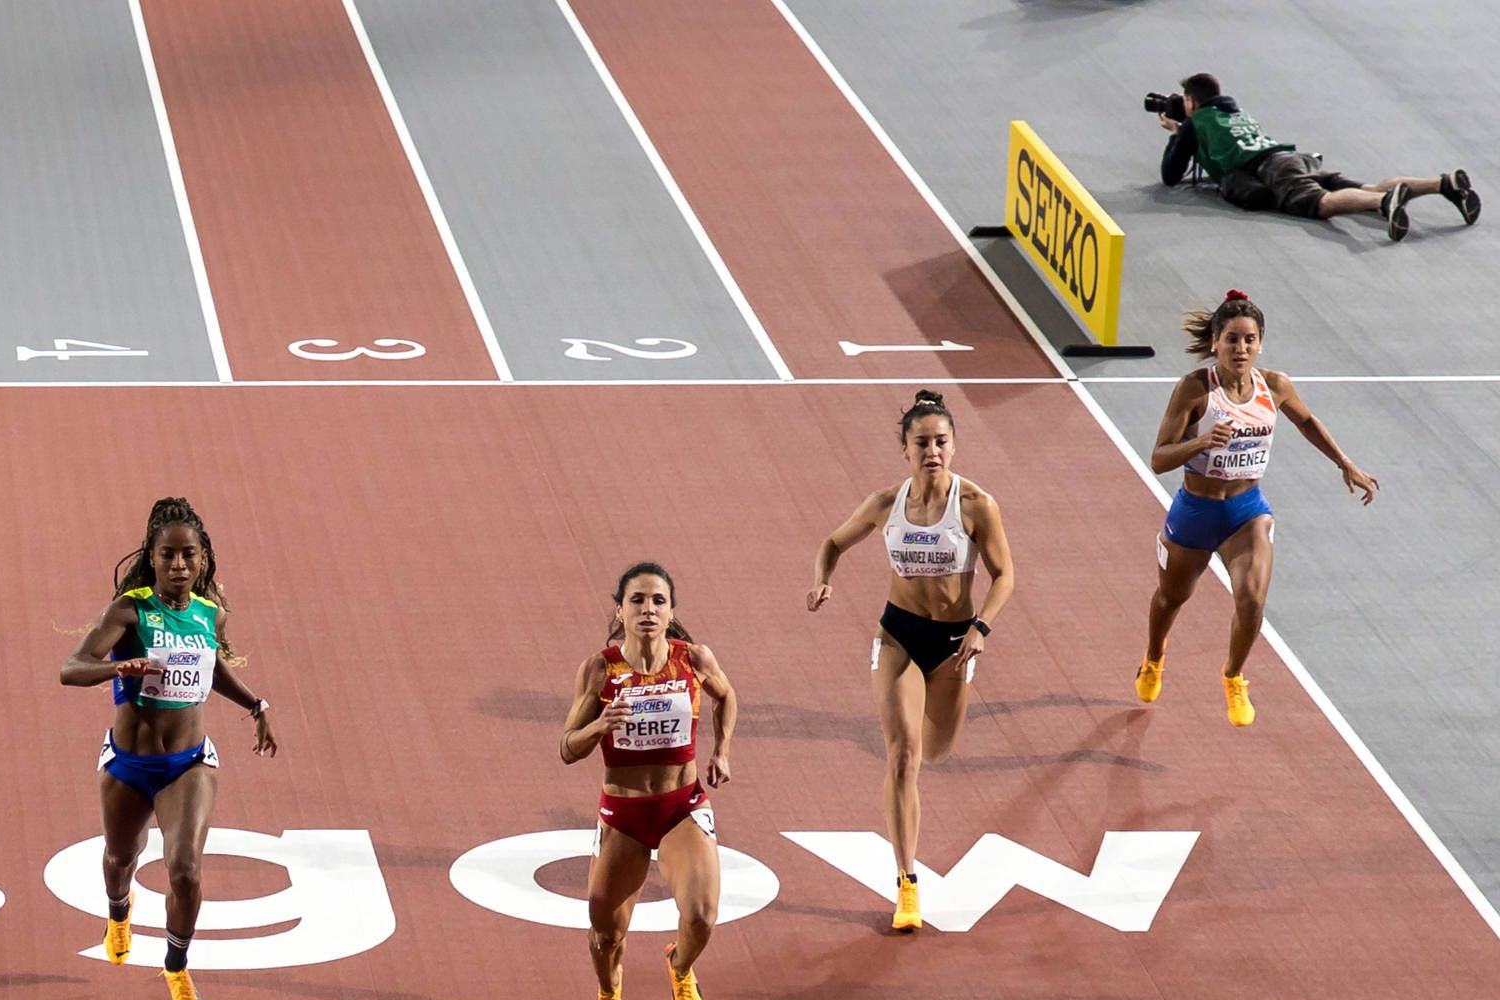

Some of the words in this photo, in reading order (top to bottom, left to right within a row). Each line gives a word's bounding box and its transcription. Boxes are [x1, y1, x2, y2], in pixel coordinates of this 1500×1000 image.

[1015, 148, 1098, 313] SEIKO
[16, 338, 149, 361] 4
[288, 339, 426, 361] 3
[560, 338, 698, 361] 2
[839, 340, 974, 356] 1
[1231, 425, 1273, 439] RAGUAY
[1213, 450, 1266, 469] GIMENEZ
[153, 630, 208, 650] BRASIL
[161, 669, 200, 687] ROSA
[620, 679, 687, 697] ESPAÑA
[626, 718, 681, 737] PÉREZ
[634, 737, 677, 747] GLASGOW
